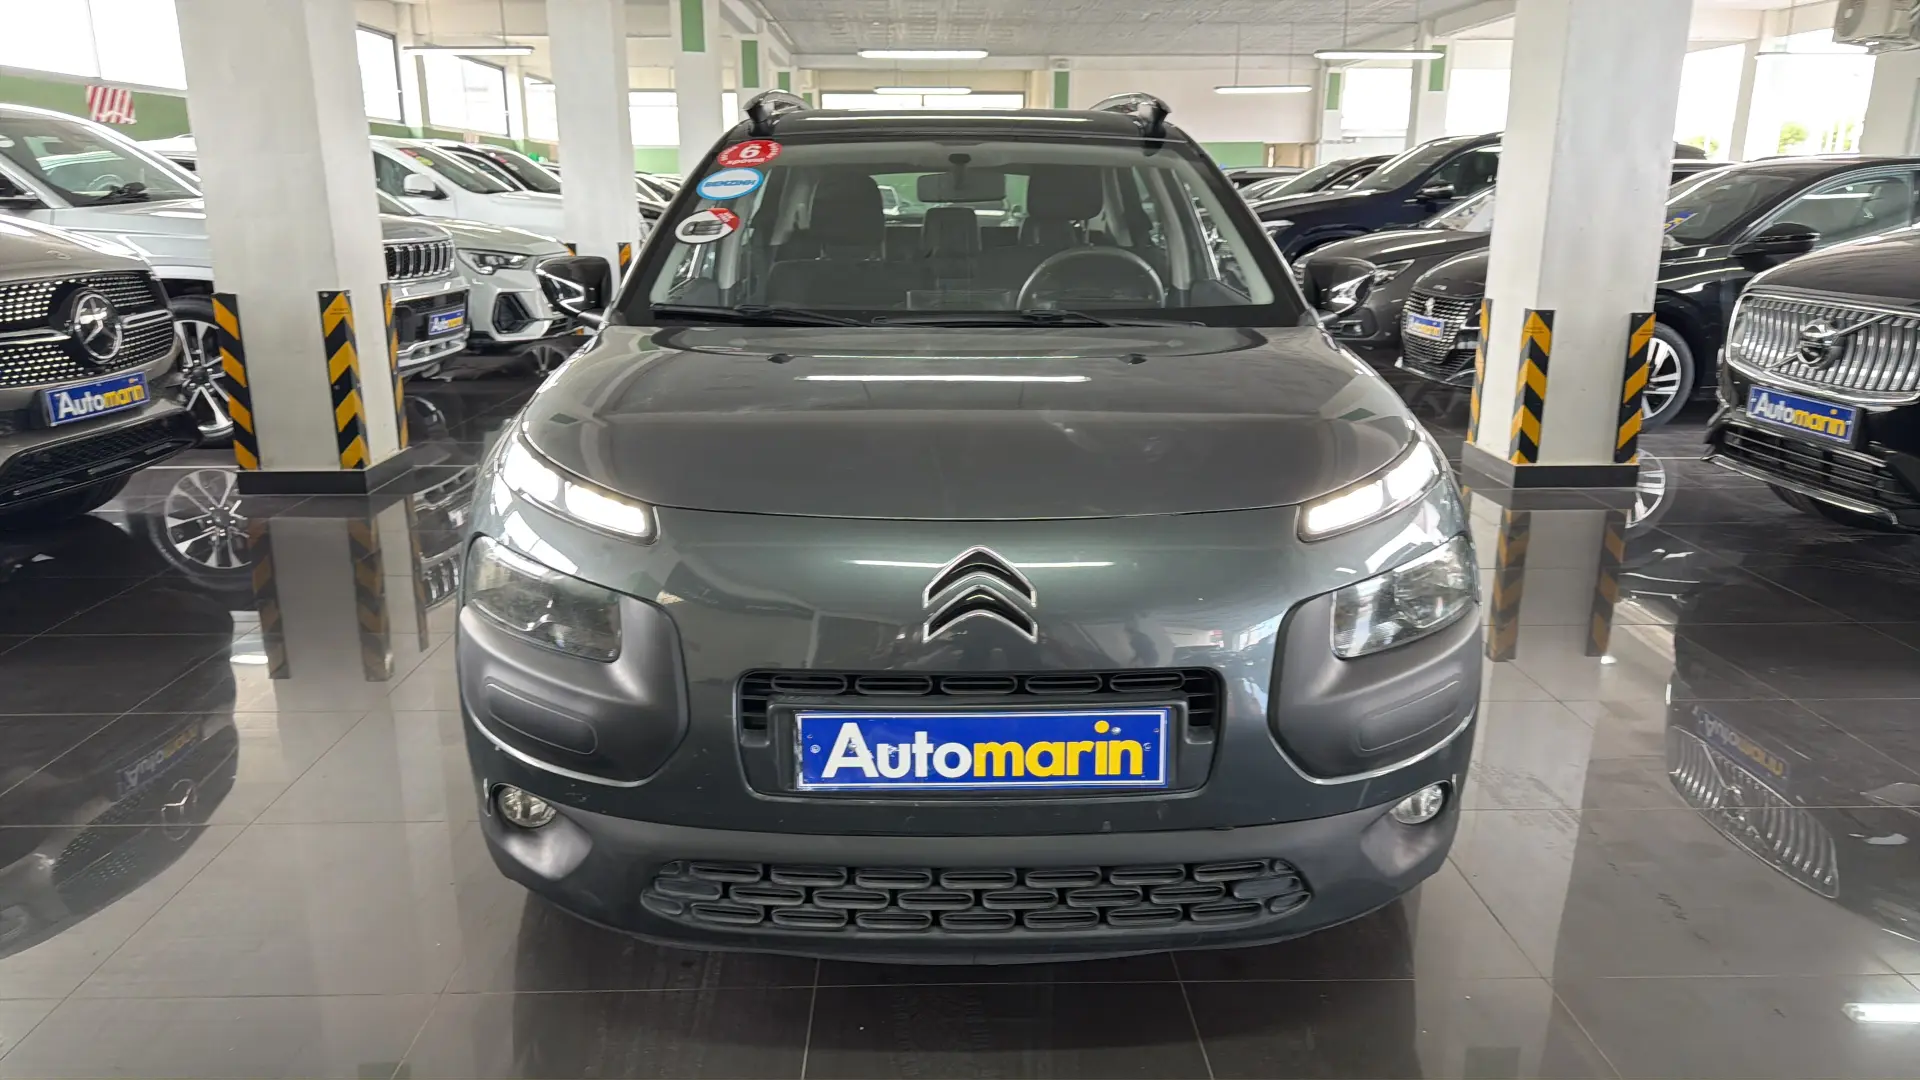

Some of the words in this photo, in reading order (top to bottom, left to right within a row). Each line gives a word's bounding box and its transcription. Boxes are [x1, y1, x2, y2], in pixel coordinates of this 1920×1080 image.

[739, 145, 762, 159] 6
[58, 378, 145, 419] Automarin
[1752, 392, 1846, 437] Automarin
[821, 720, 1143, 778] Automarin
